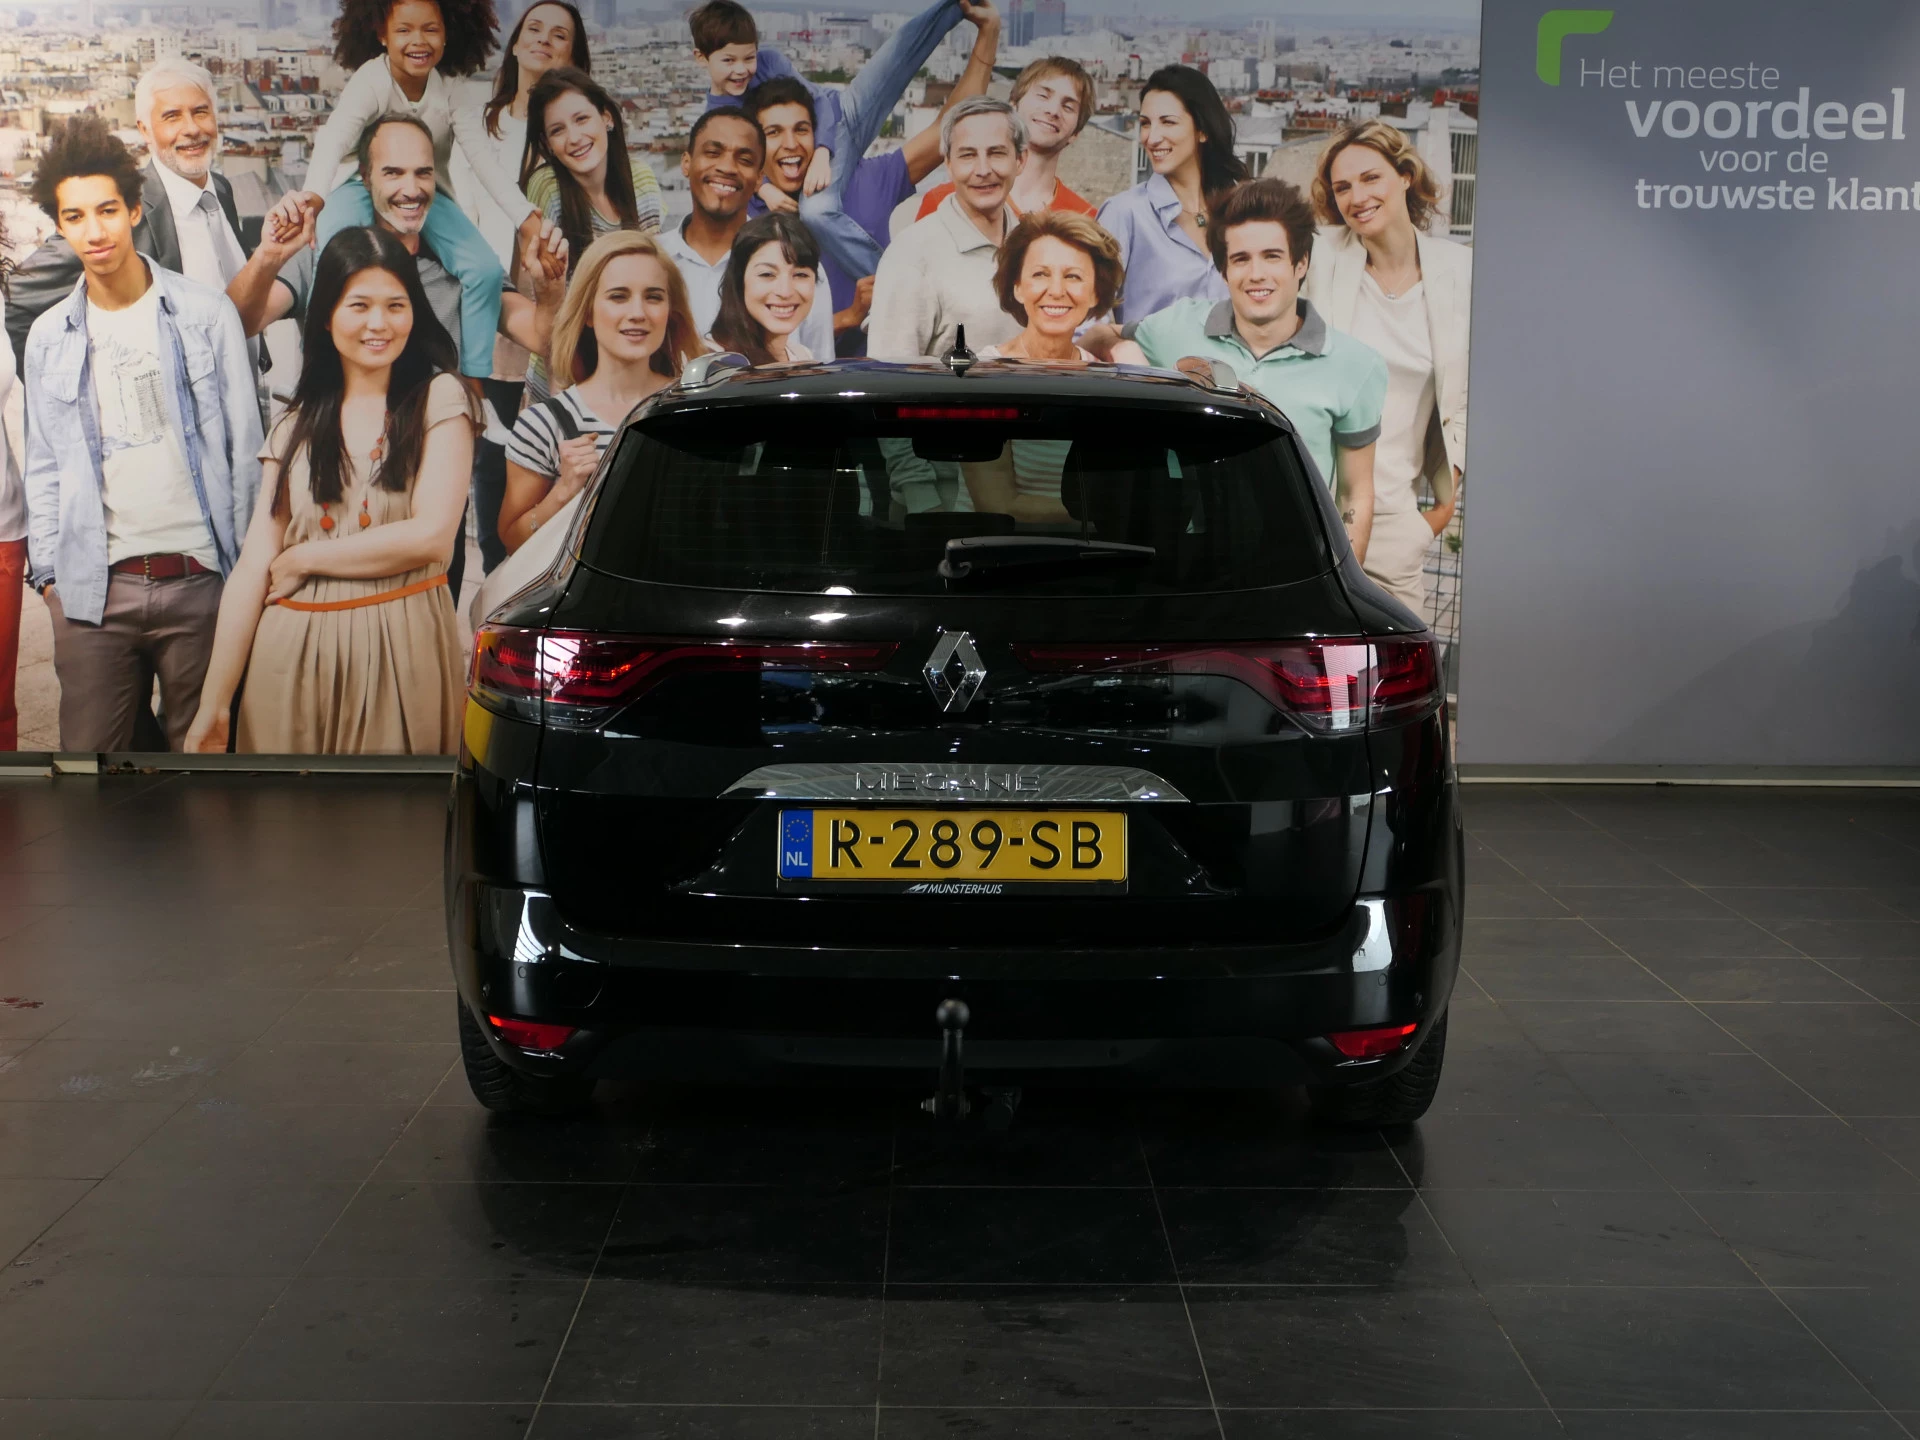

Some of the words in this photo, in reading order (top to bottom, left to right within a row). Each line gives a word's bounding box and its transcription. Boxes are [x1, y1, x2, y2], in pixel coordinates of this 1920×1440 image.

[1579, 58, 1641, 88] Het
[1654, 61, 1780, 90] meeste
[1624, 87, 1906, 140] voordeel
[1699, 149, 1778, 172] voor
[1786, 143, 1829, 173] de
[1635, 178, 1815, 210] trouwste
[1827, 177, 1920, 211] klant
[786, 851, 808, 867] NL
[831, 819, 1103, 869] R-289-SB
[928, 884, 1003, 896] MUNSTERHUIS
